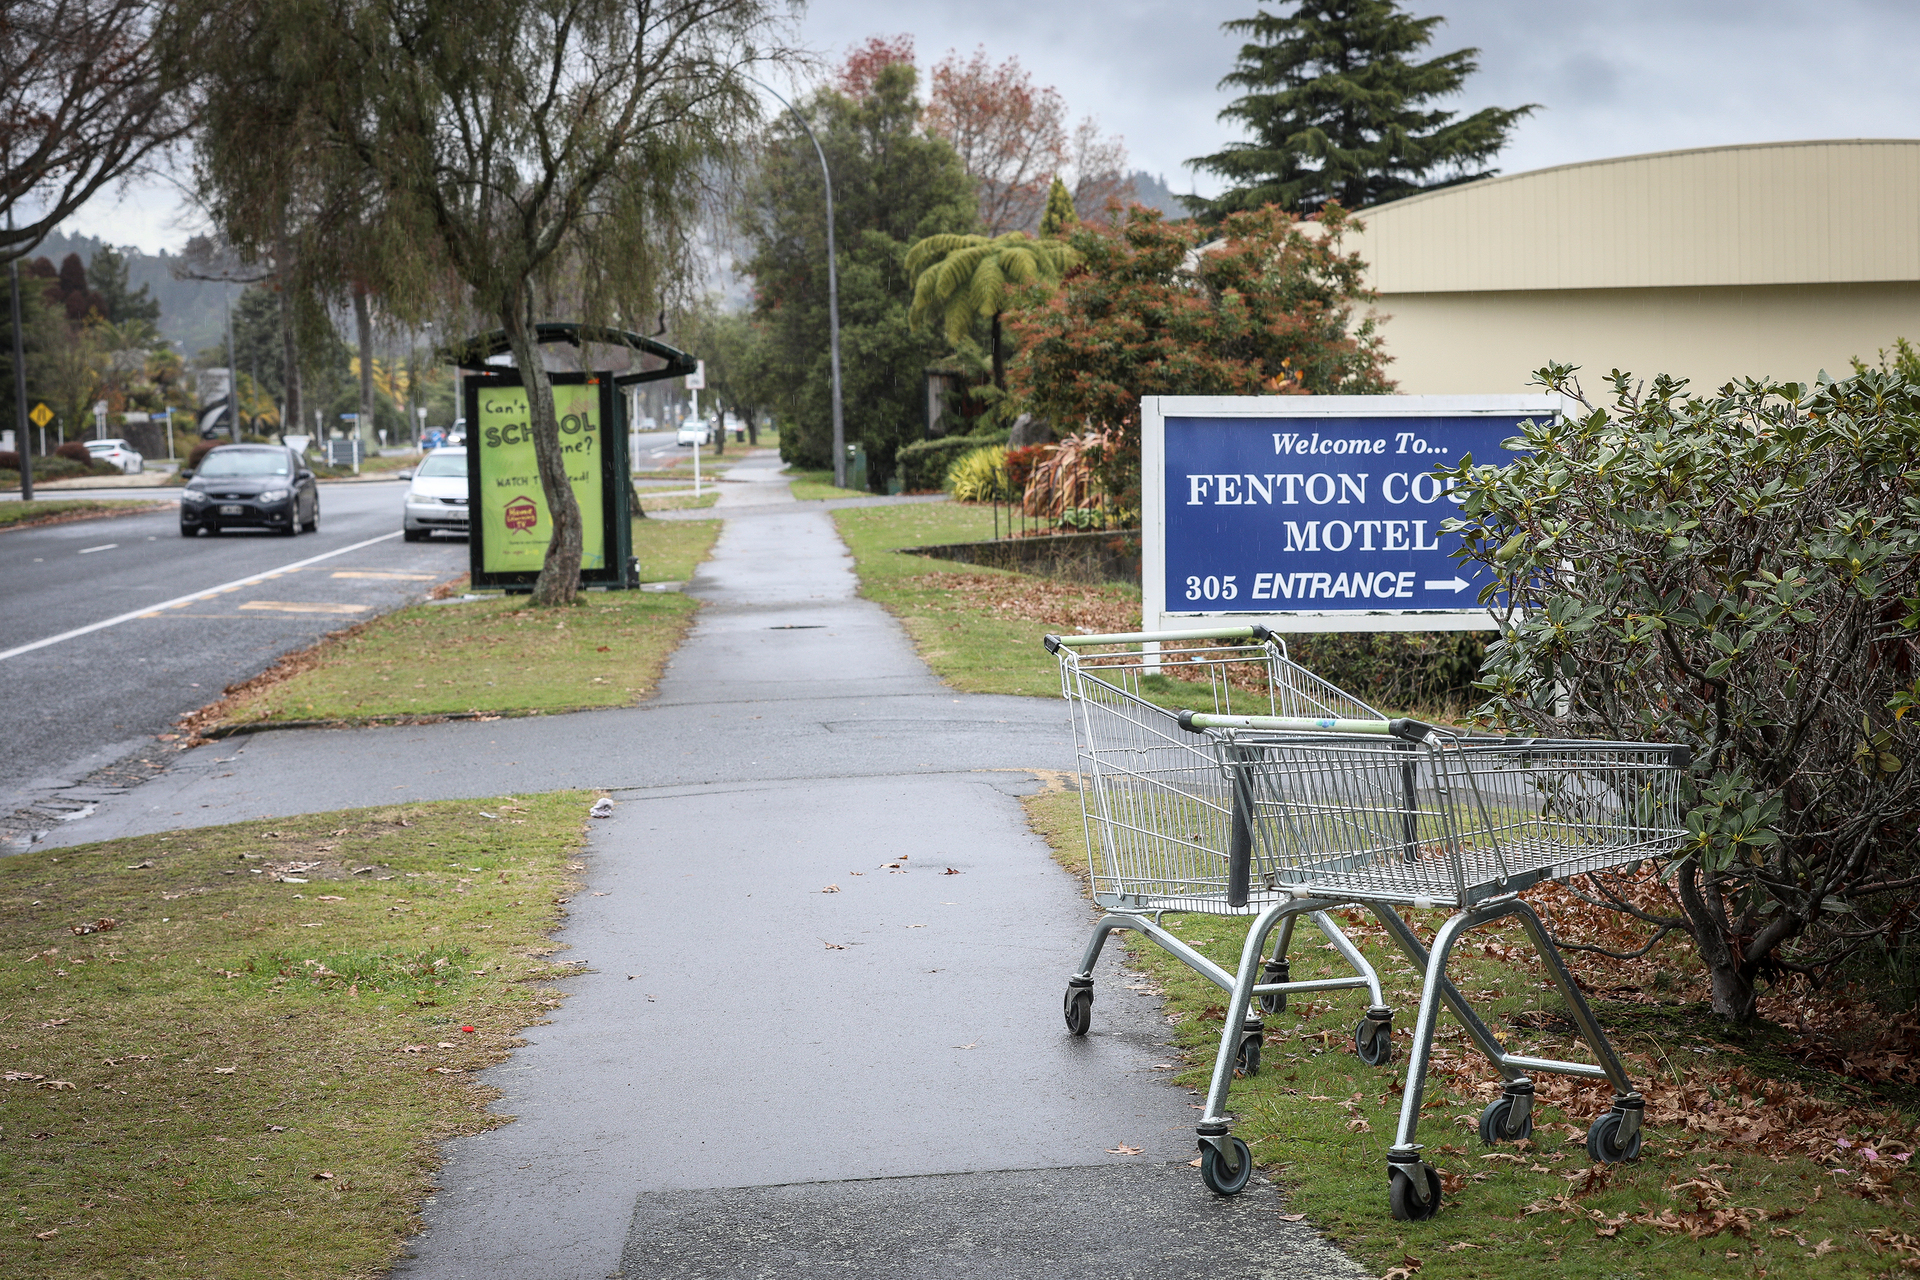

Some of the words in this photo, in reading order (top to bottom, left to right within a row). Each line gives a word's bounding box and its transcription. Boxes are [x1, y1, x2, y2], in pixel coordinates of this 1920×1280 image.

[485, 399, 527, 415] Can't
[484, 411, 596, 448] SCHOL
[1272, 432, 1386, 455] Welcome
[1394, 432, 1449, 455] To...
[496, 475, 528, 488] WATCH
[1186, 472, 1369, 506] FENTON
[1283, 520, 1439, 553] MOTEL
[1185, 575, 1238, 601] 305
[1251, 571, 1416, 600] ENTRANCE
